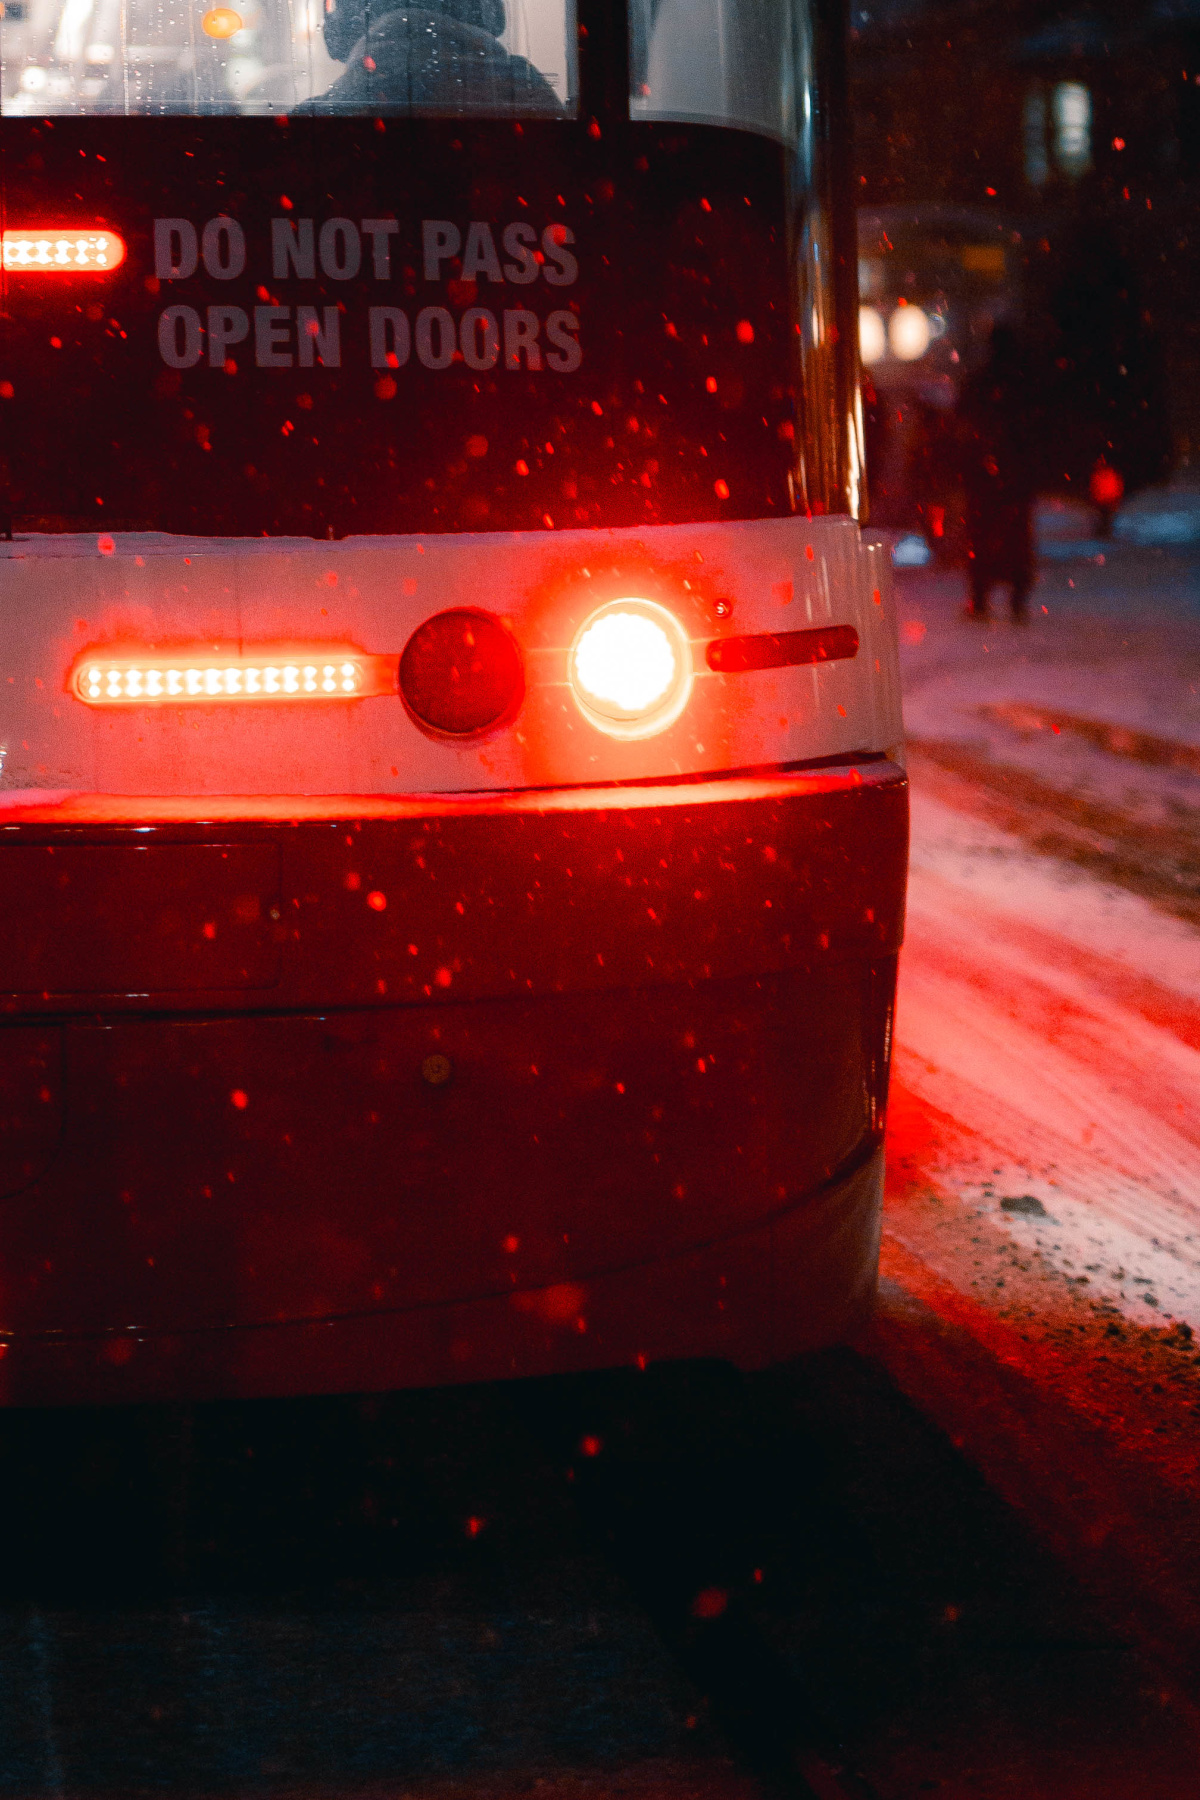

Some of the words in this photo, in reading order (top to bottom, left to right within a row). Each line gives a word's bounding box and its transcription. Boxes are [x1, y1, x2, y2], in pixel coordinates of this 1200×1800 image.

[153, 217, 246, 280] DO
[271, 217, 399, 280] NOT
[421, 219, 579, 286] PASS
[157, 304, 342, 369] OPEN
[368, 306, 583, 373] DOORS
